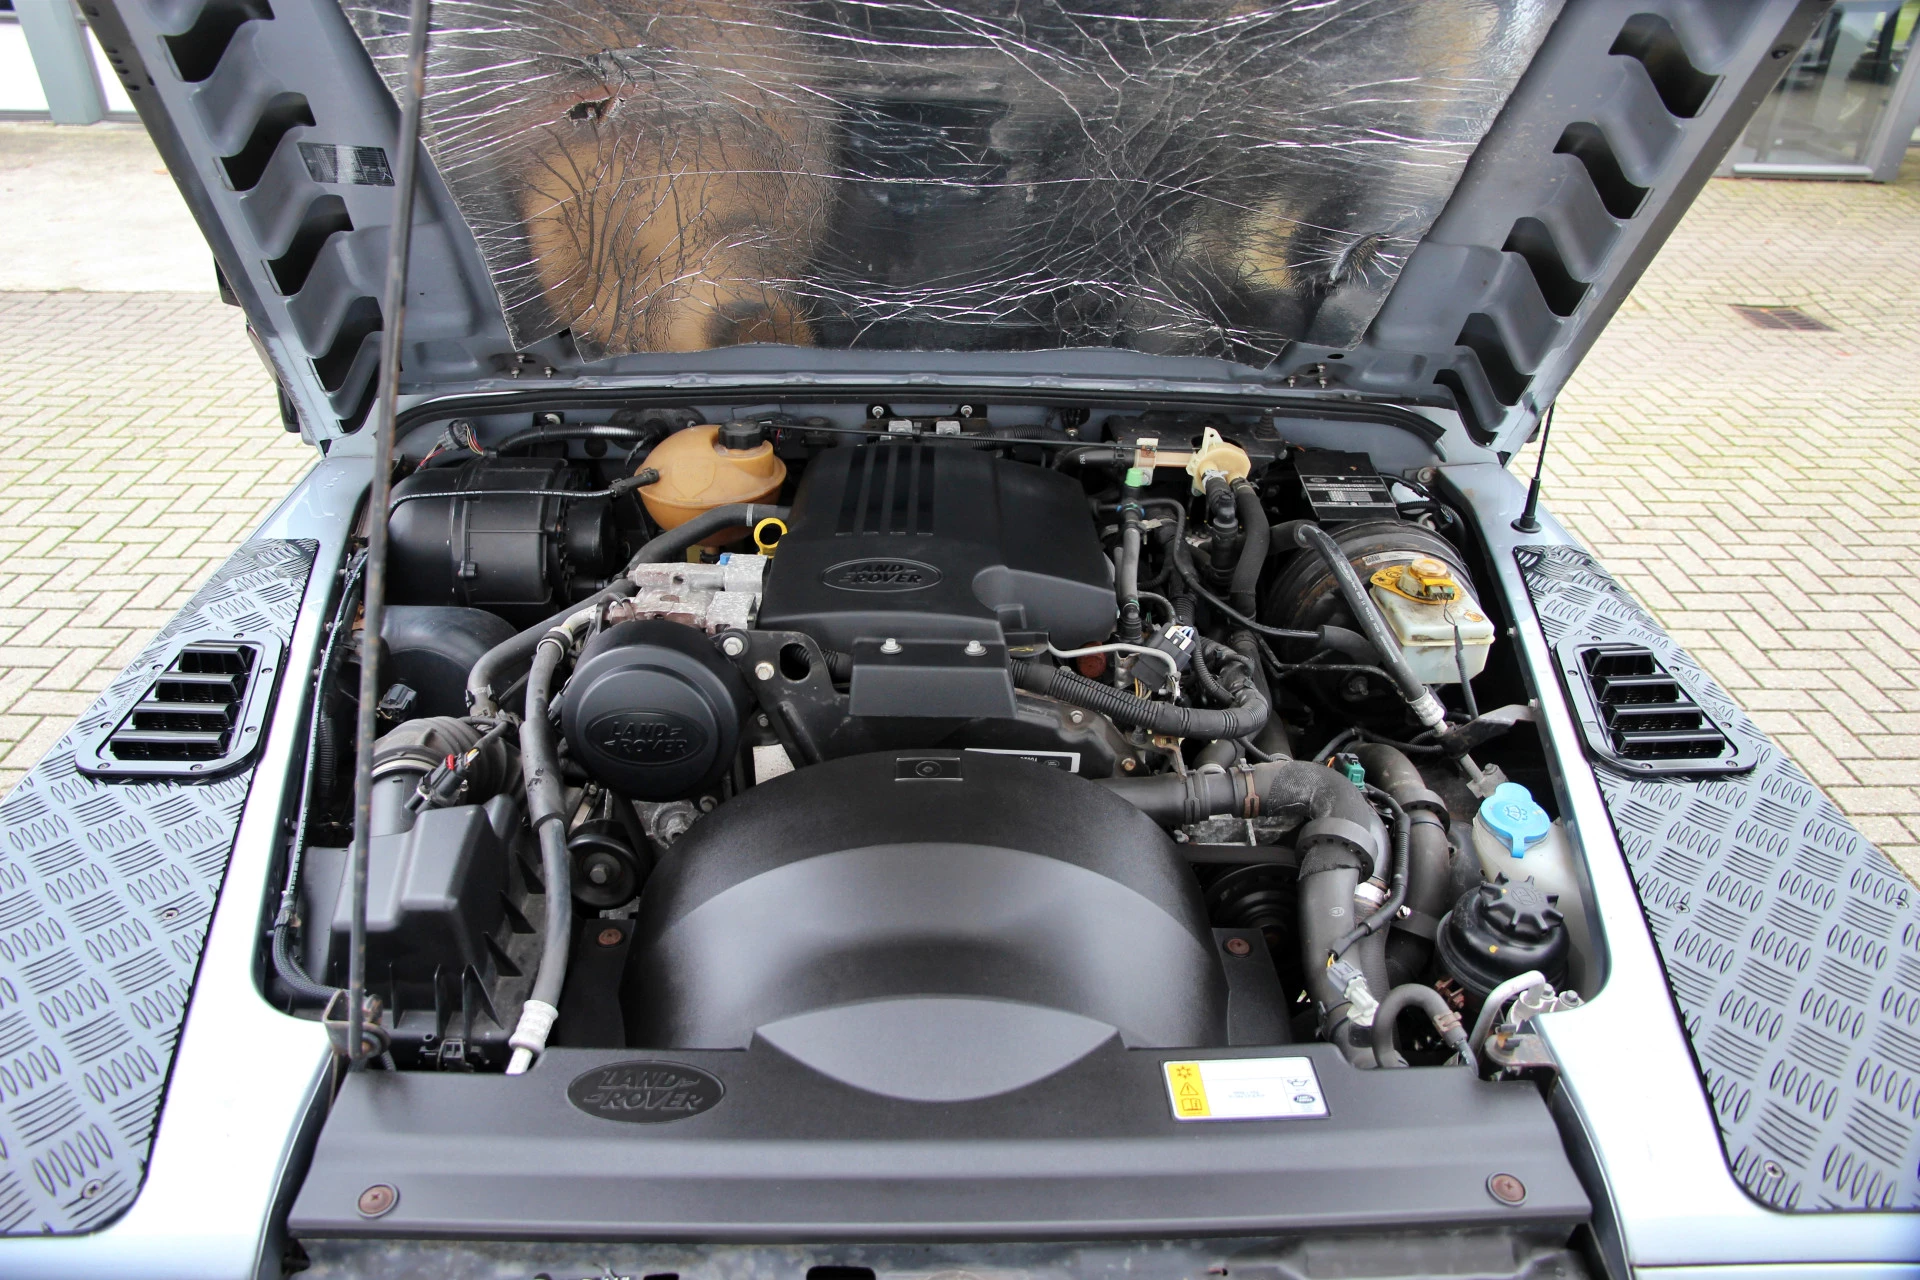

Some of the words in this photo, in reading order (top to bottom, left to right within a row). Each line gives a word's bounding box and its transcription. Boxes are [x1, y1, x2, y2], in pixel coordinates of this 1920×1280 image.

[847, 564, 905, 573] LAND
[850, 573, 922, 584] ROVER
[610, 721, 669, 737] LAND
[617, 738, 688, 753] ROVER
[598, 1070, 680, 1090] LAND
[600, 1090, 703, 1110] ROVER
